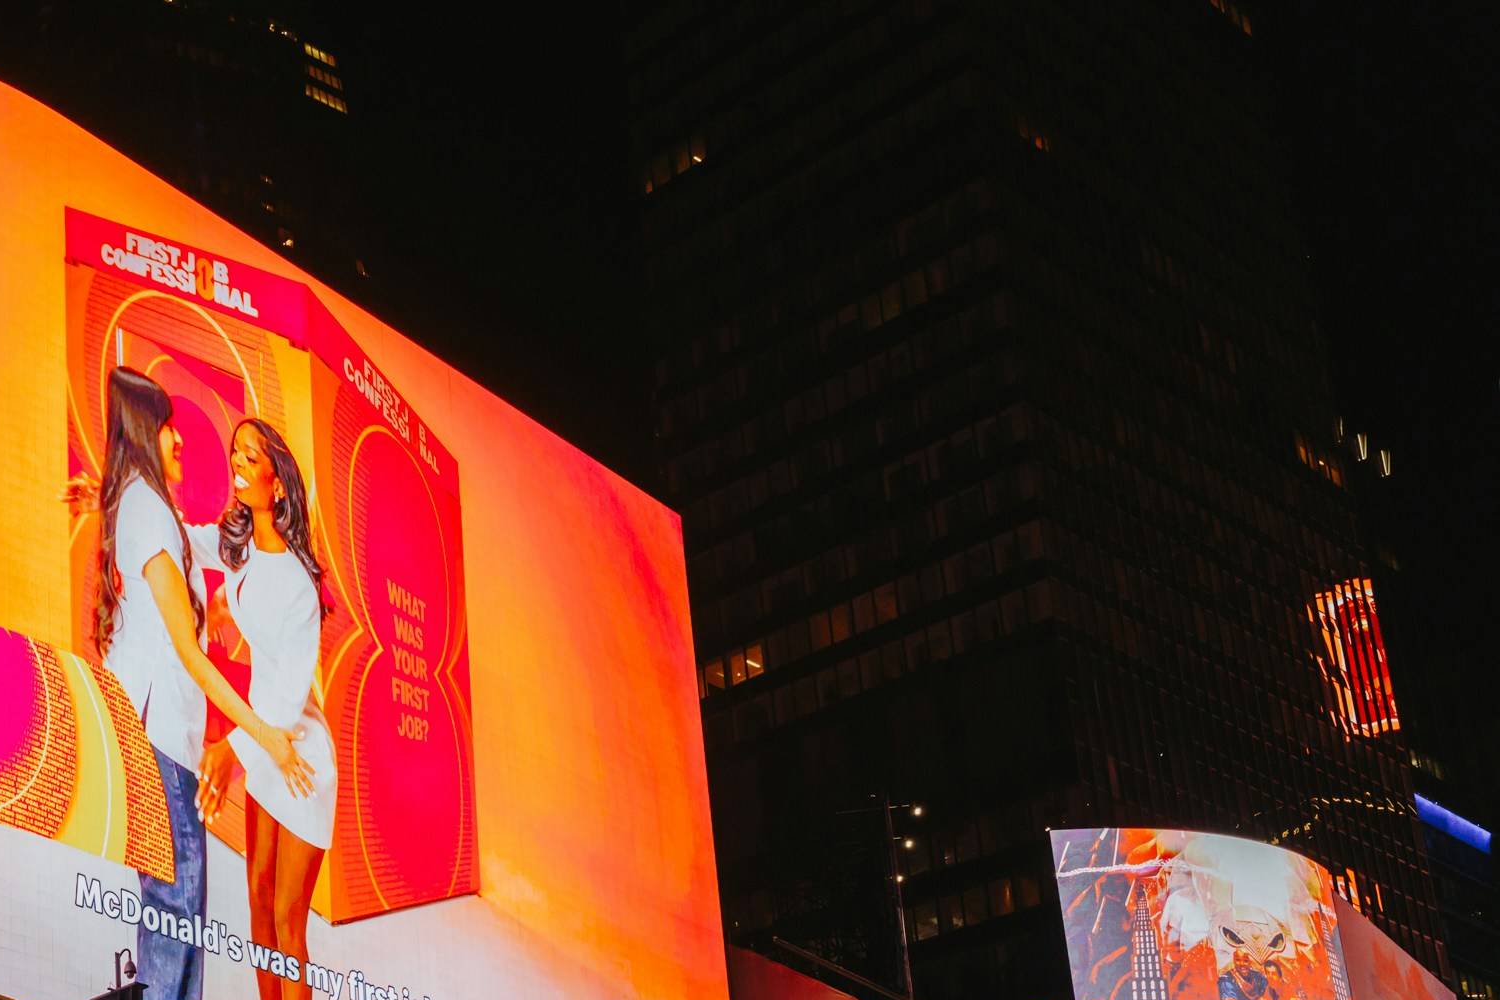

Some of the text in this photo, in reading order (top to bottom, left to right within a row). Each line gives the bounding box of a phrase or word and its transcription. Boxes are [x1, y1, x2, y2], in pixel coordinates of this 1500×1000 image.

[126, 232, 181, 268] FIRST
[364, 358, 400, 412] FIRST
[386, 578, 426, 624] WHAT
[393, 614, 423, 651] WAS
[392, 643, 428, 682] YOUR
[391, 676, 430, 712] FIRST
[397, 712, 430, 742] JOB?
[74, 872, 244, 963] McDonald's
[247, 941, 301, 982] was
